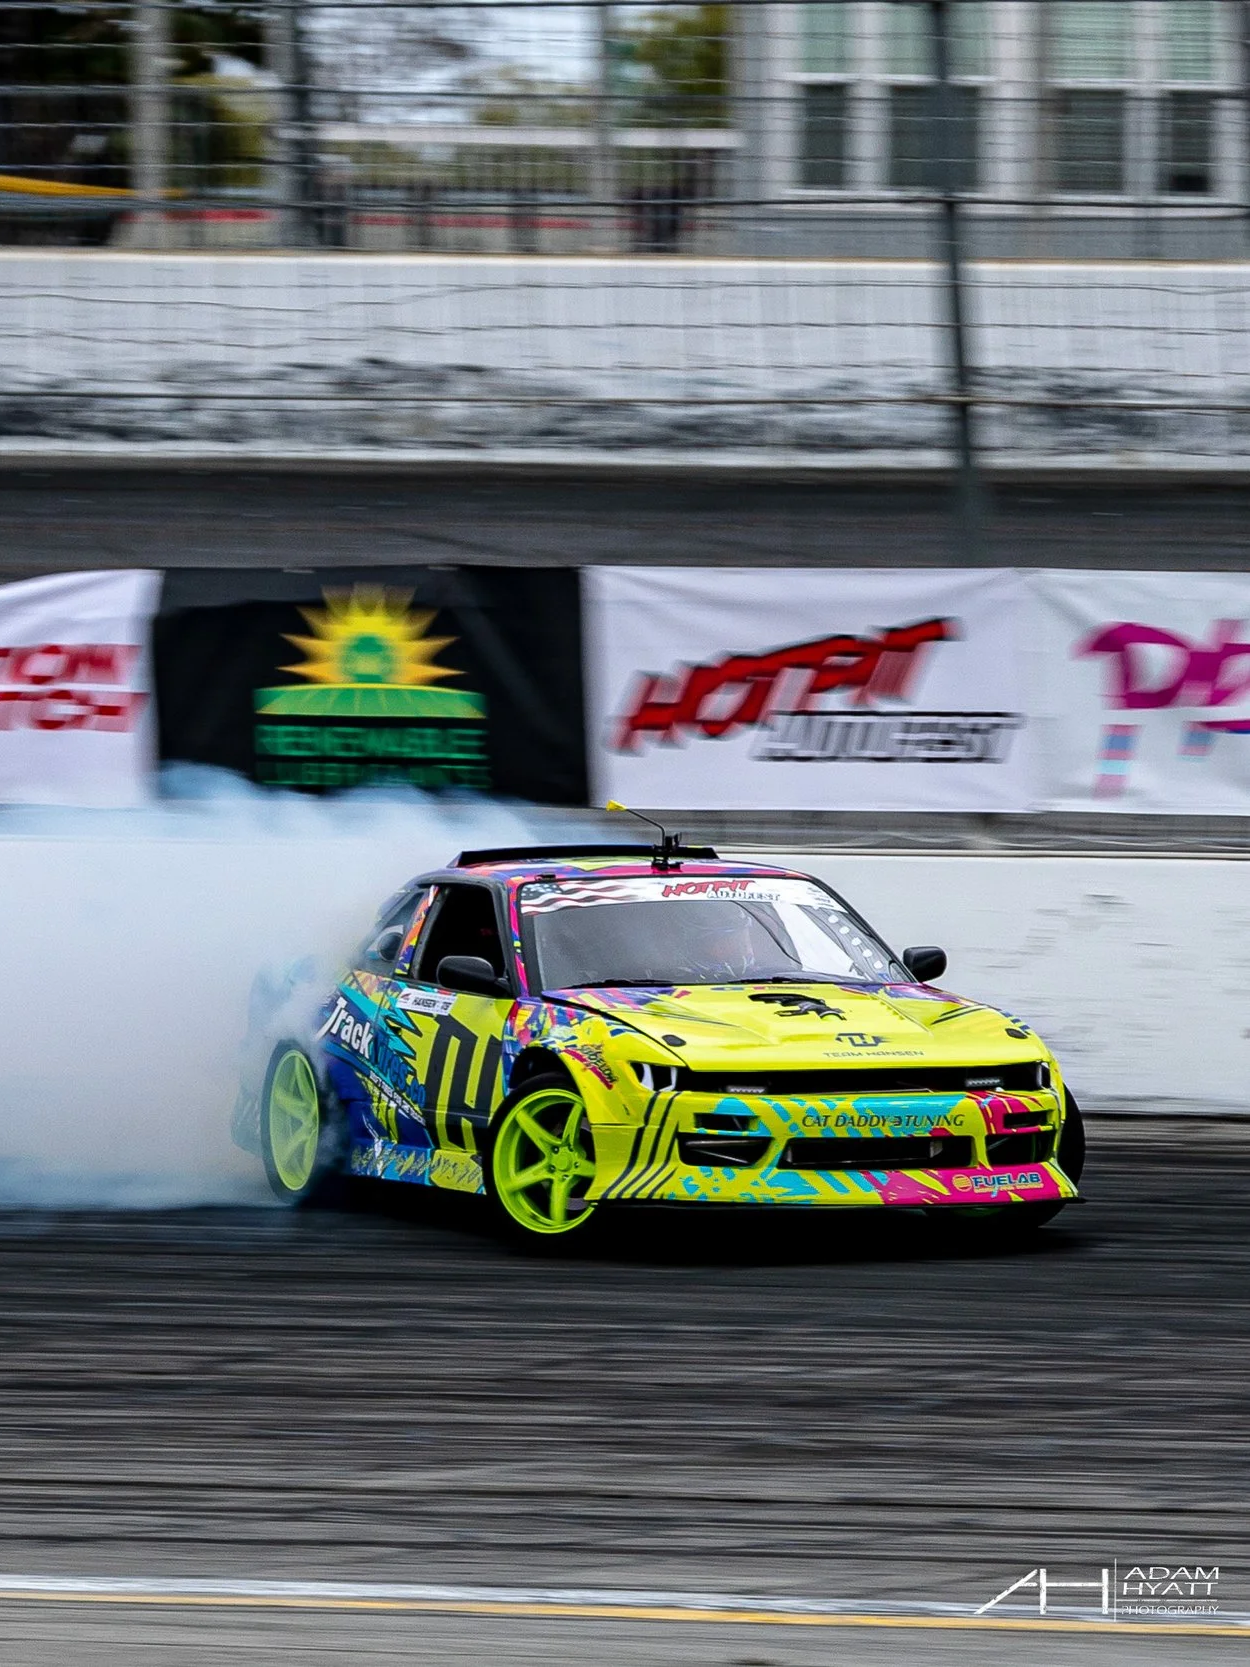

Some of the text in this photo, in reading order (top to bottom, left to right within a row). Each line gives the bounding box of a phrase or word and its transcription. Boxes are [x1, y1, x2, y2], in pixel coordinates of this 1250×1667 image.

[661, 879, 756, 898] HOTPIT
[313, 996, 374, 1060] Track
[801, 1114, 966, 1128] CAT DADDY TUNING
[970, 1171, 1042, 1188] FUELAB
